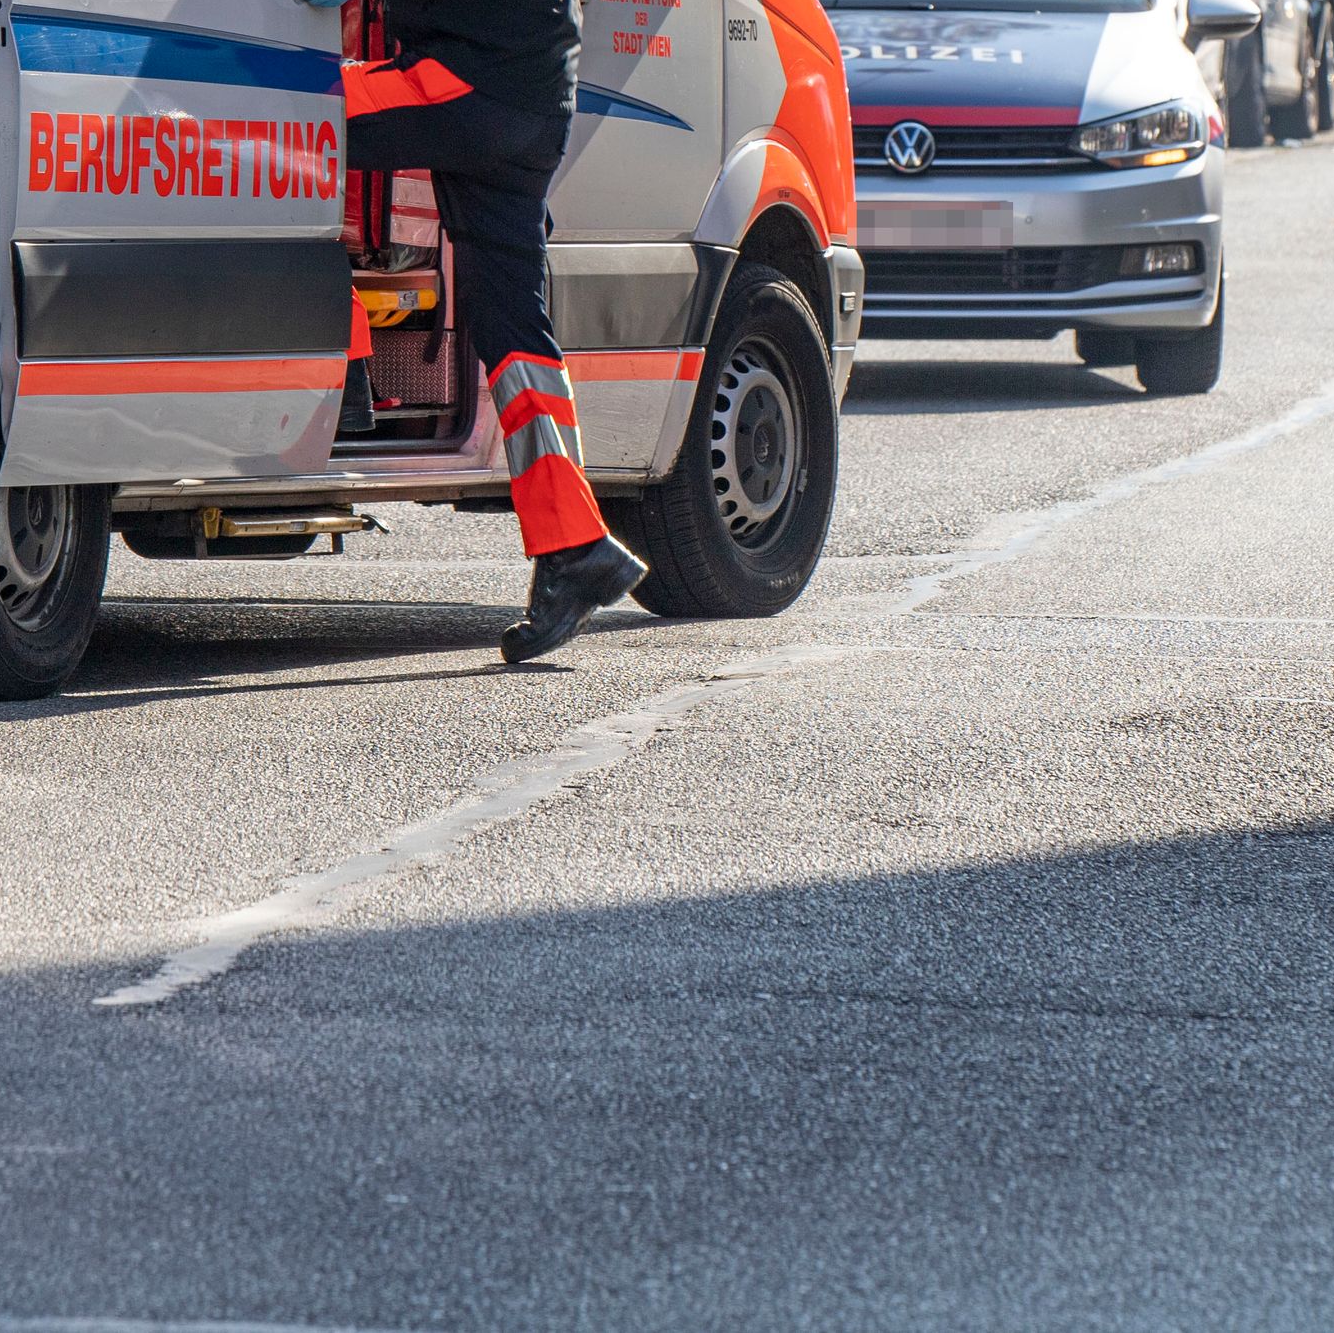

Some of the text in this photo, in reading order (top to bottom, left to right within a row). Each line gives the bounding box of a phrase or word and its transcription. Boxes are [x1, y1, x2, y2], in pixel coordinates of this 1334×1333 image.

[635, 12, 648, 26] DER
[728, 19, 758, 42] 9692-70
[613, 31, 671, 57] STADT WIEN
[841, 45, 1023, 64] OLIZEI
[28, 112, 337, 200] BERUFSRETTUNG
